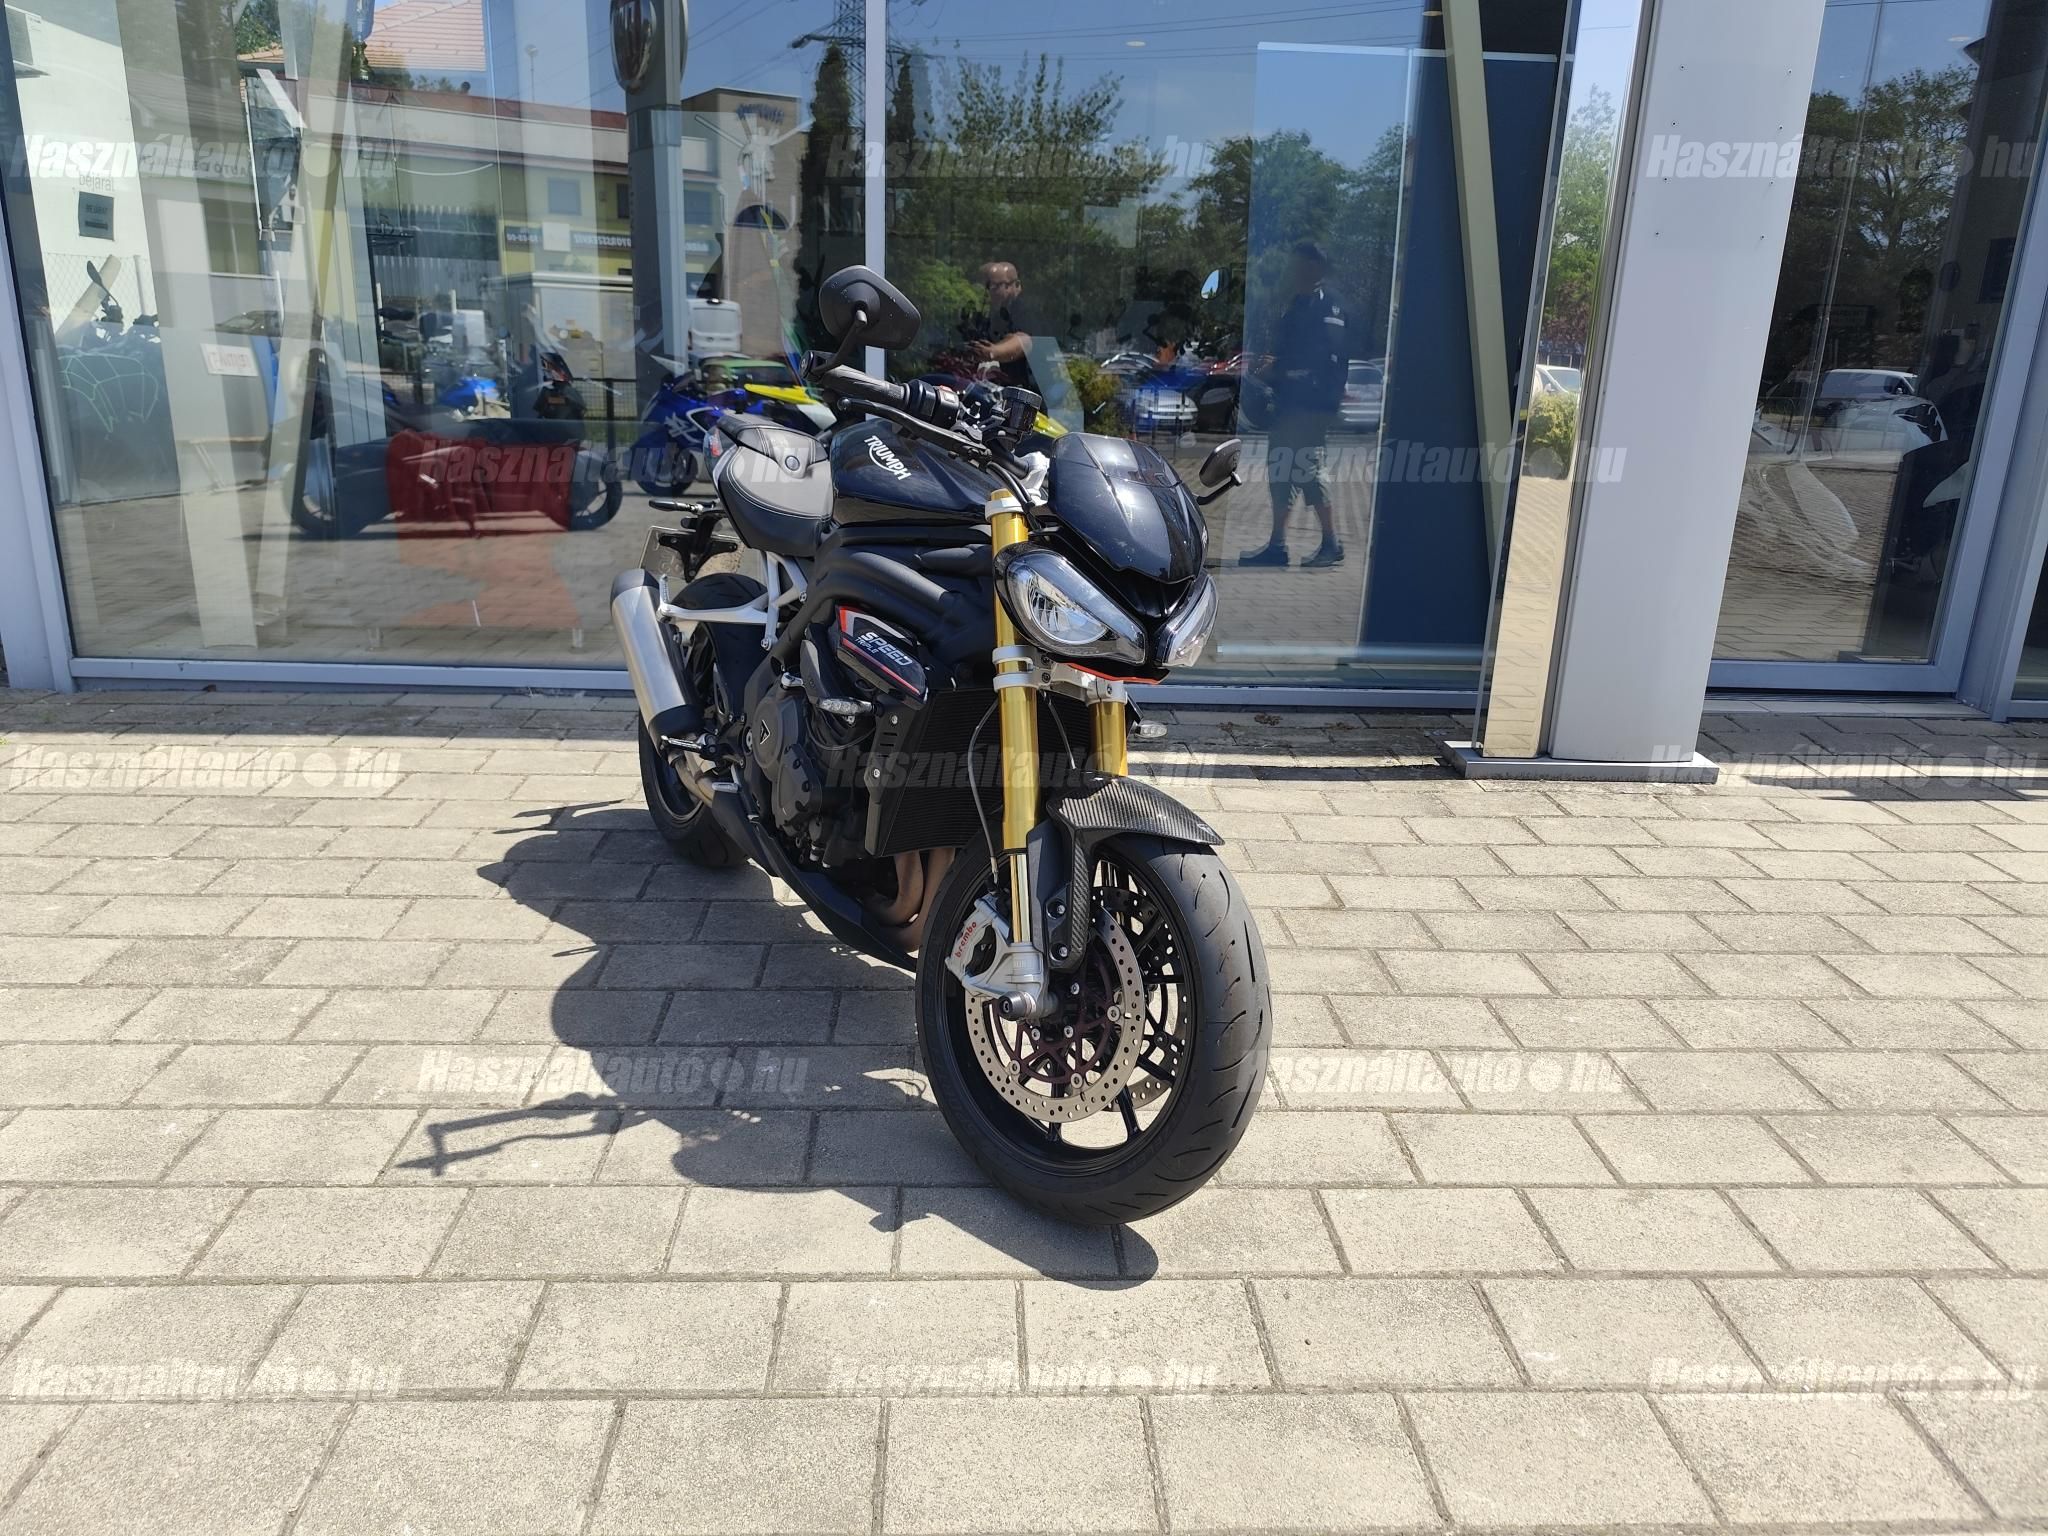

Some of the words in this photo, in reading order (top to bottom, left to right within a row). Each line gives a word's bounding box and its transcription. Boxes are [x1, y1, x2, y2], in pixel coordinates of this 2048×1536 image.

[864, 435, 912, 480] TRIUMPH
[855, 637, 879, 654] TRIPLE
[860, 631, 913, 666] SPEED
[954, 921, 977, 958] brembo
